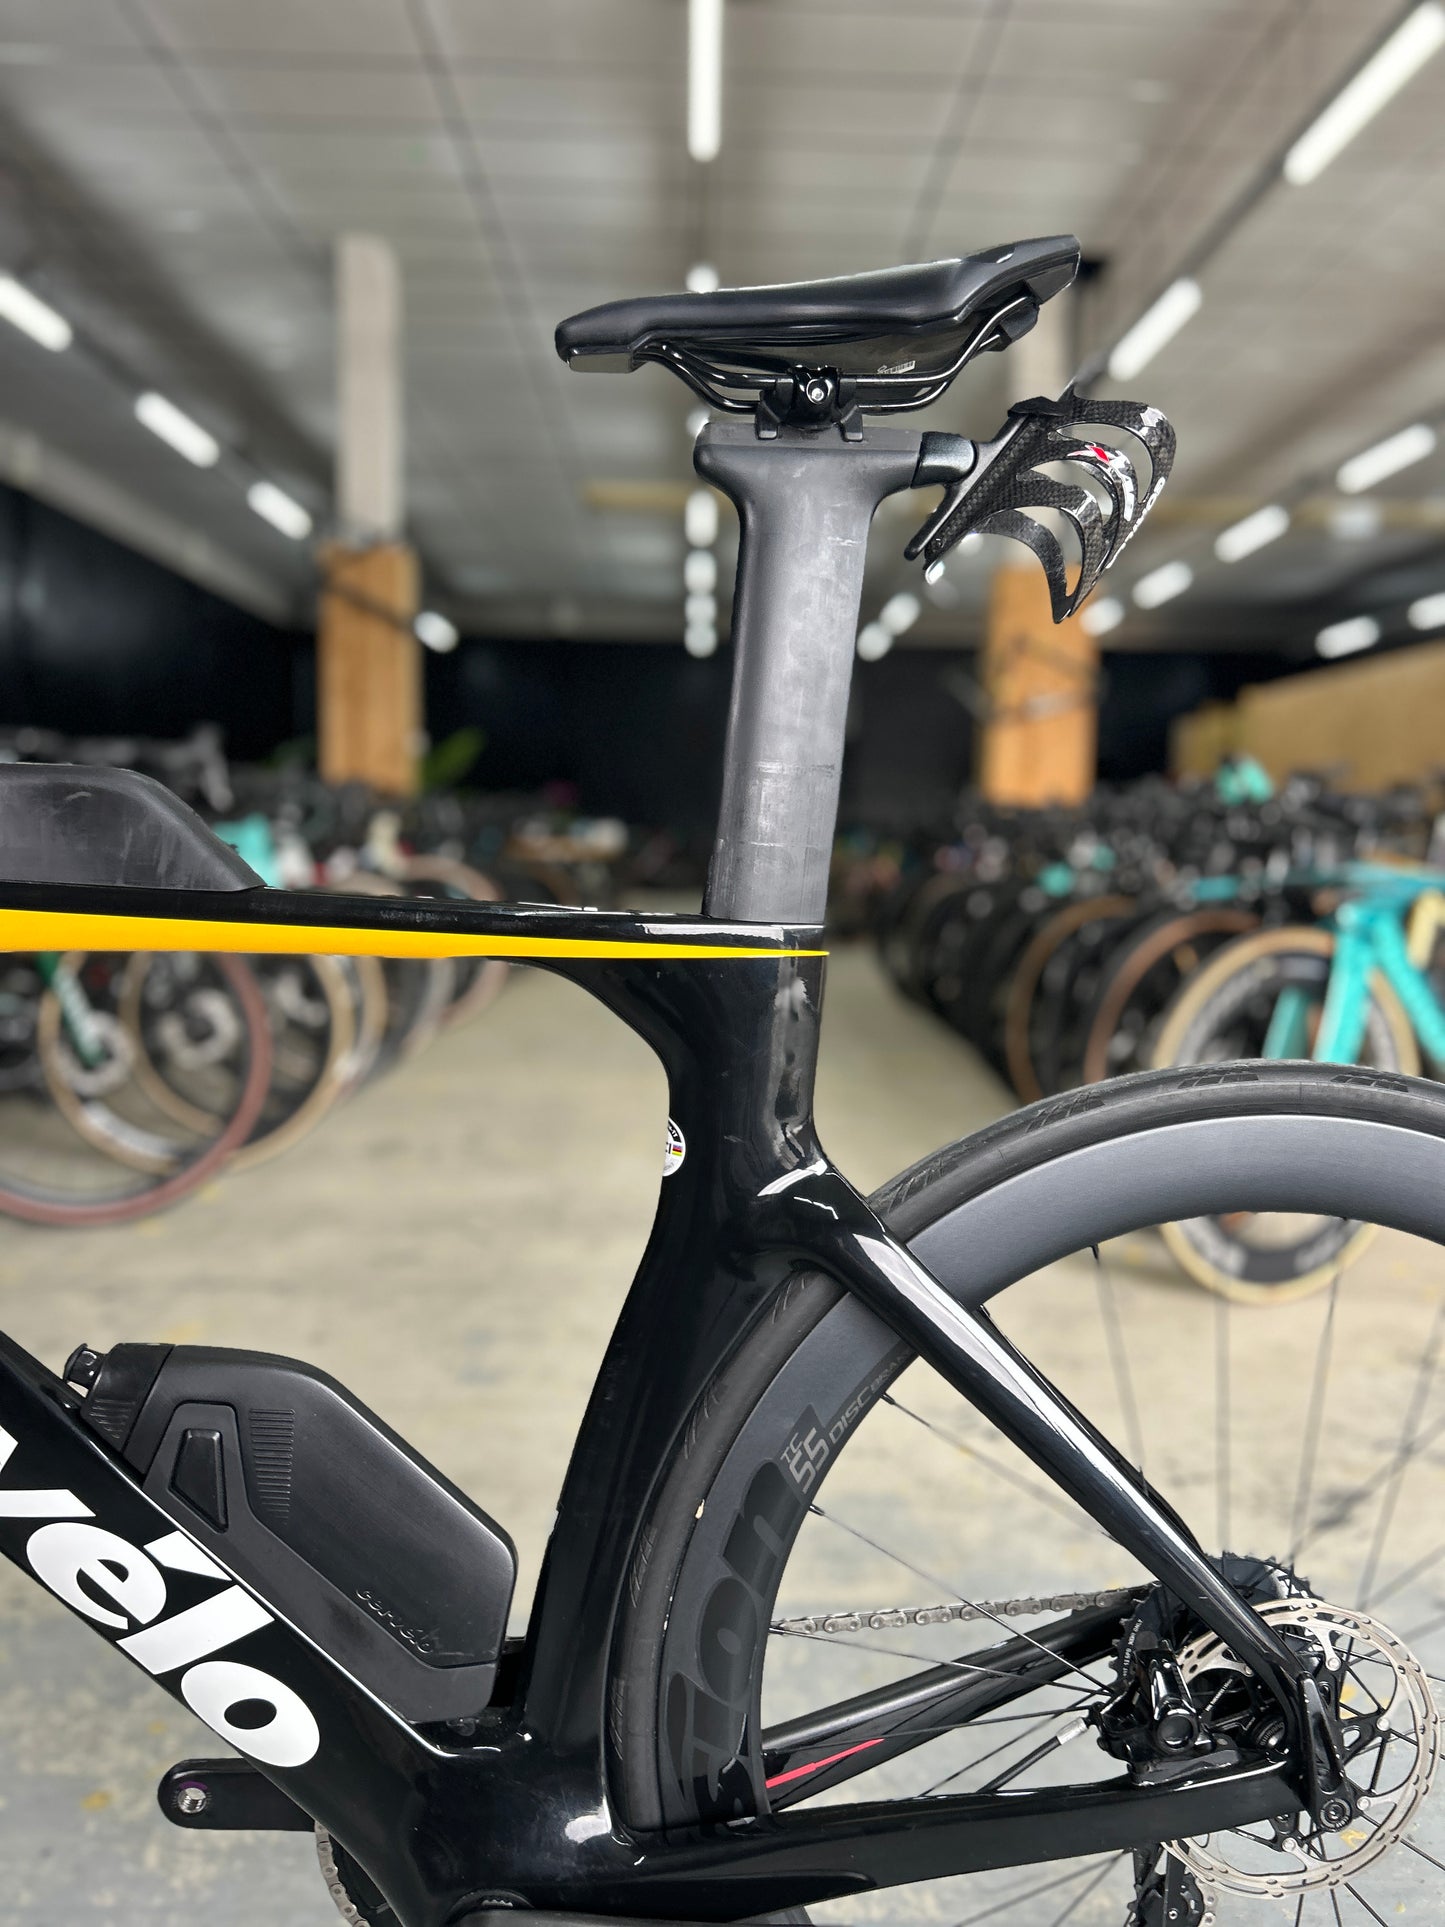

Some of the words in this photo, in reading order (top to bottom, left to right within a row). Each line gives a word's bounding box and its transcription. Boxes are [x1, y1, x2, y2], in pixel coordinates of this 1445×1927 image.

[829, 1386, 872, 1444] DISC
[780, 1432, 803, 1464] TC
[789, 1427, 830, 1494] 55
[356, 1589, 433, 1654] cervélo
